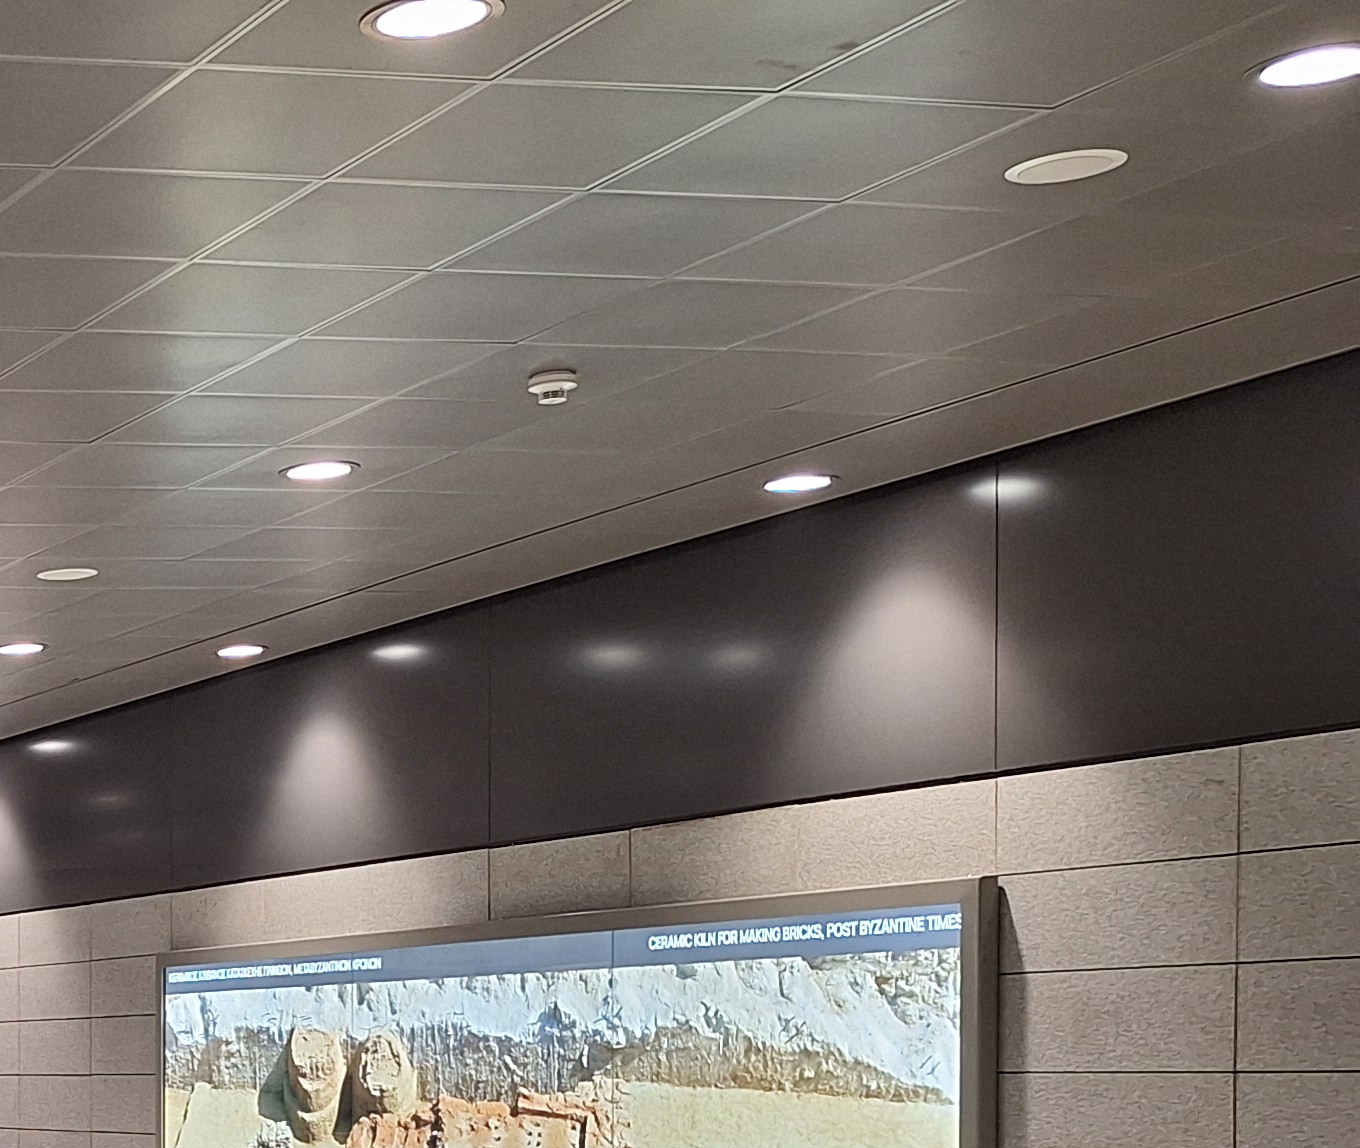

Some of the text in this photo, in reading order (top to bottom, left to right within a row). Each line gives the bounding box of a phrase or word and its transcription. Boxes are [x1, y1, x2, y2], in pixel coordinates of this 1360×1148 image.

[648, 913, 963, 950] CERAMIC KILN FOR MAKING BRICKS, POST BYZANTINE TIMES
